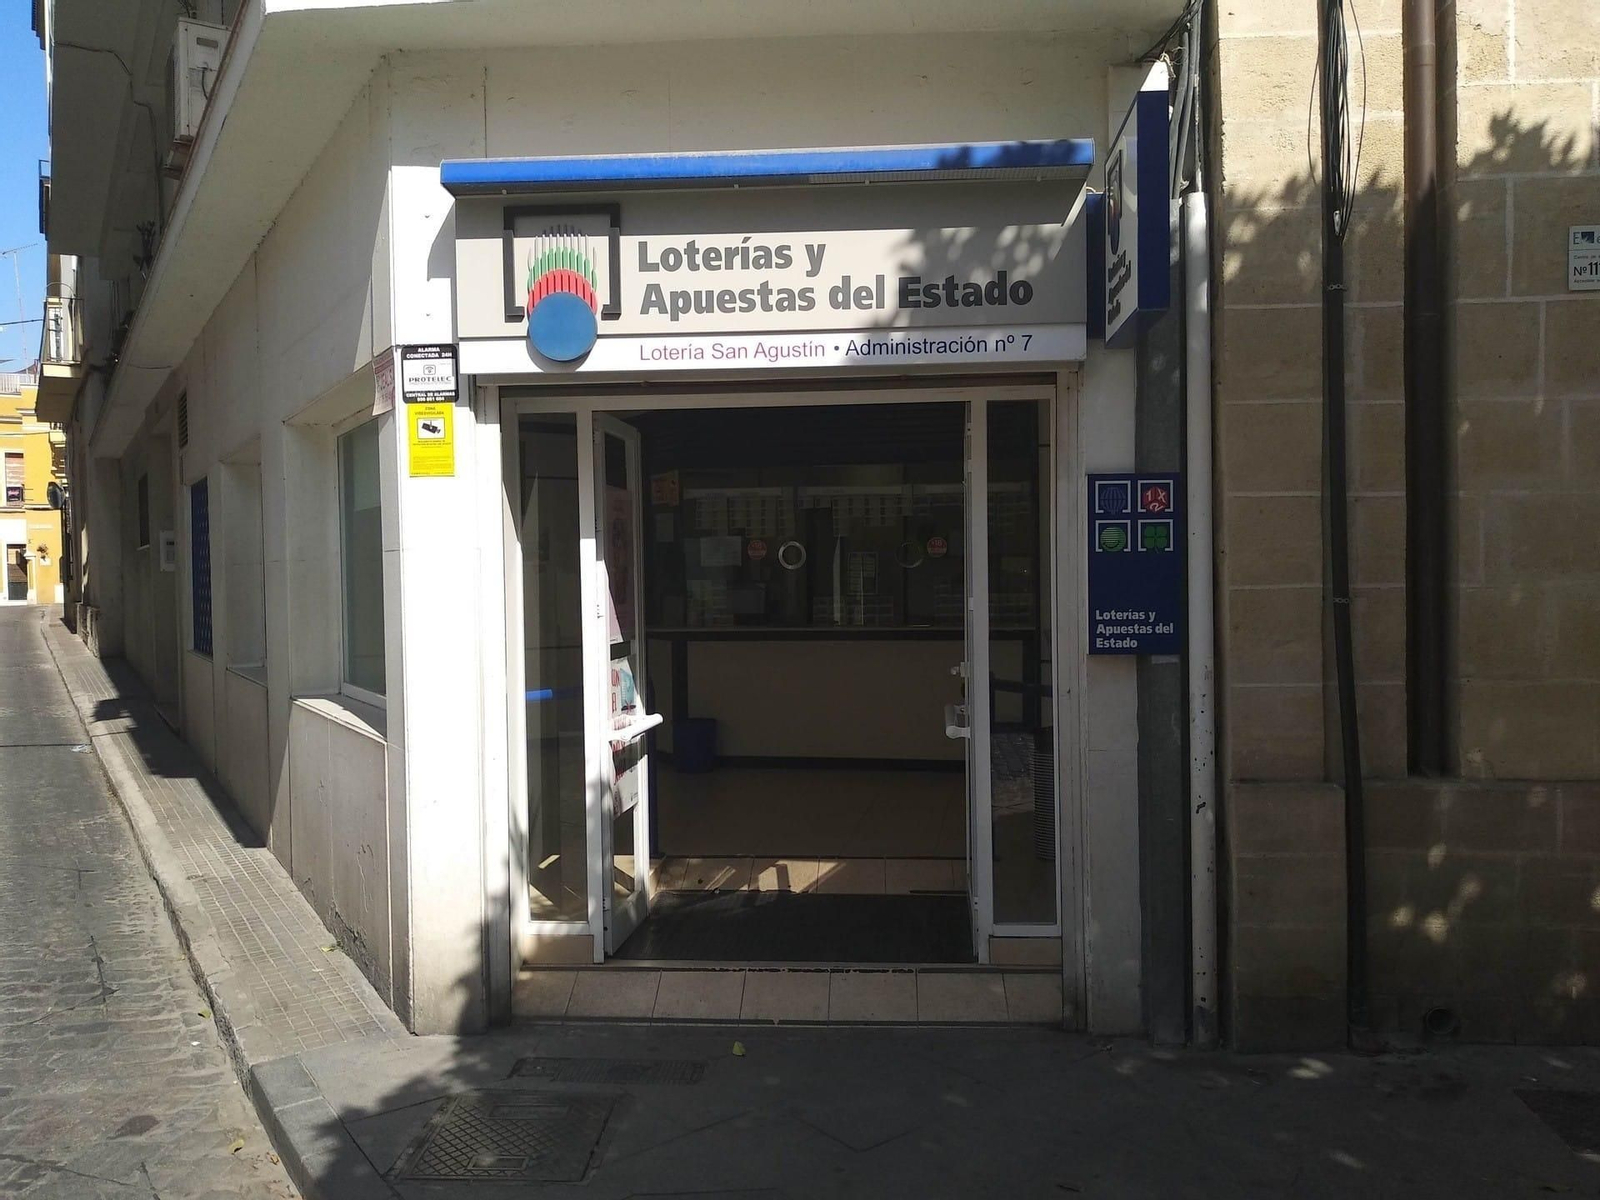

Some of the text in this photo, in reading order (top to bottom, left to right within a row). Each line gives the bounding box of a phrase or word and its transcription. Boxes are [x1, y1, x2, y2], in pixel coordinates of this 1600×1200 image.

[638, 237, 827, 278] Loterías y
[640, 270, 1034, 322] Apuestas del Estado
[640, 335, 1033, 363] Lotería San Agustín Administración nº 7
[408, 375, 452, 383] PROTELEC
[1096, 608, 1156, 622] Loterías y
[1096, 623, 1174, 636] Apuestas del
[1096, 638, 1138, 648] Estado
